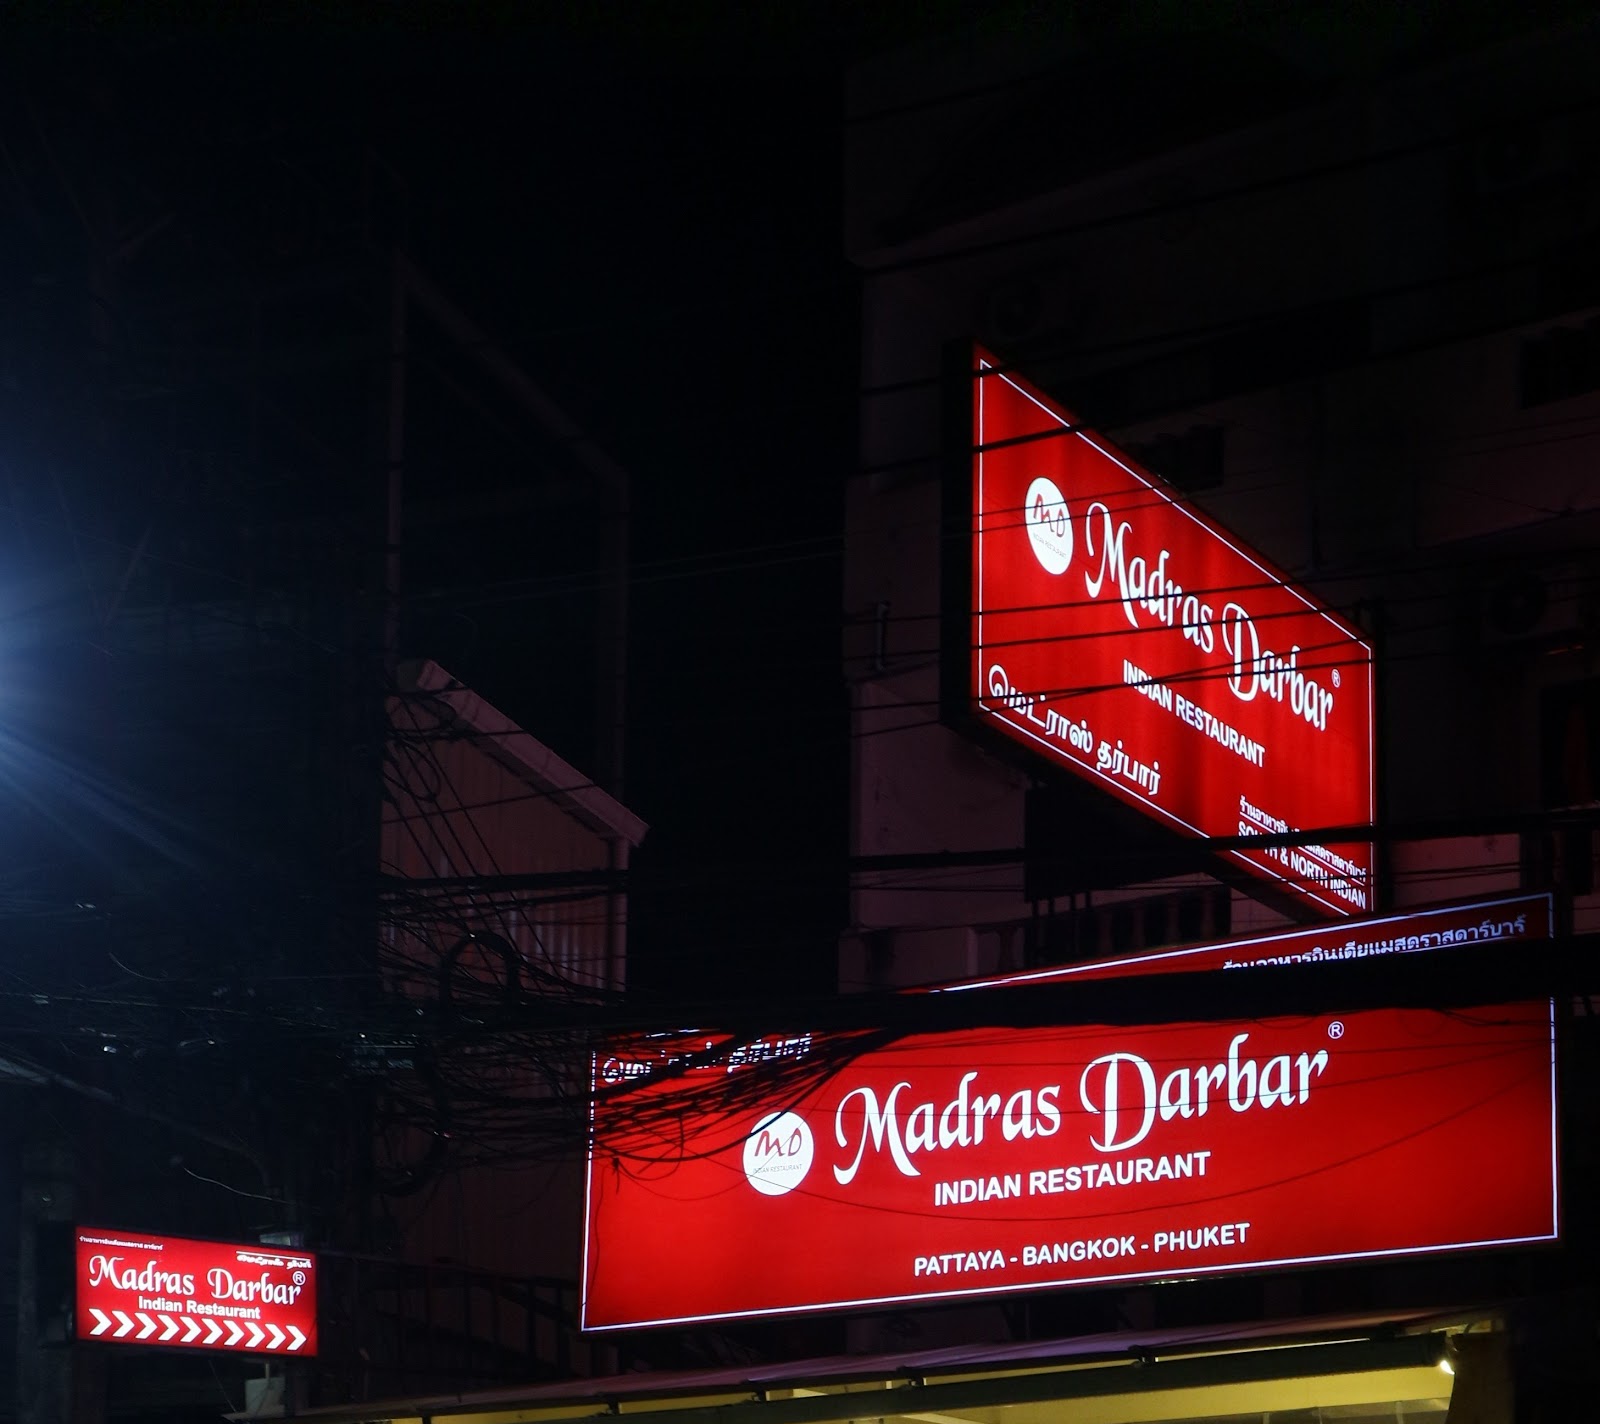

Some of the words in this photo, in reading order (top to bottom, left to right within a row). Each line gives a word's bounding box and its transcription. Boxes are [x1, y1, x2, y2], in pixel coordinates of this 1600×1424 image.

[1085, 502, 1214, 653] Madras
[1123, 658, 1172, 712] INDIAN
[1175, 693, 1266, 768] RESTAURANT
[1096, 739, 1161, 796] தர்பார்
[1280, 846, 1289, 867] &
[1290, 850, 1328, 889] NORTH
[1330, 873, 1366, 910] INDIAN
[833, 1071, 1061, 1185] Madras
[934, 1173, 1021, 1206] INDIAN
[1029, 1151, 1212, 1196] RESTAURANT
[89, 1255, 195, 1296] Madras
[914, 1249, 1006, 1277] PATTAYA
[1022, 1235, 1136, 1267] BANGKOK
[1154, 1222, 1251, 1254] PHUKET
[138, 1295, 182, 1313] Indian
[187, 1300, 261, 1320] Restaurant
